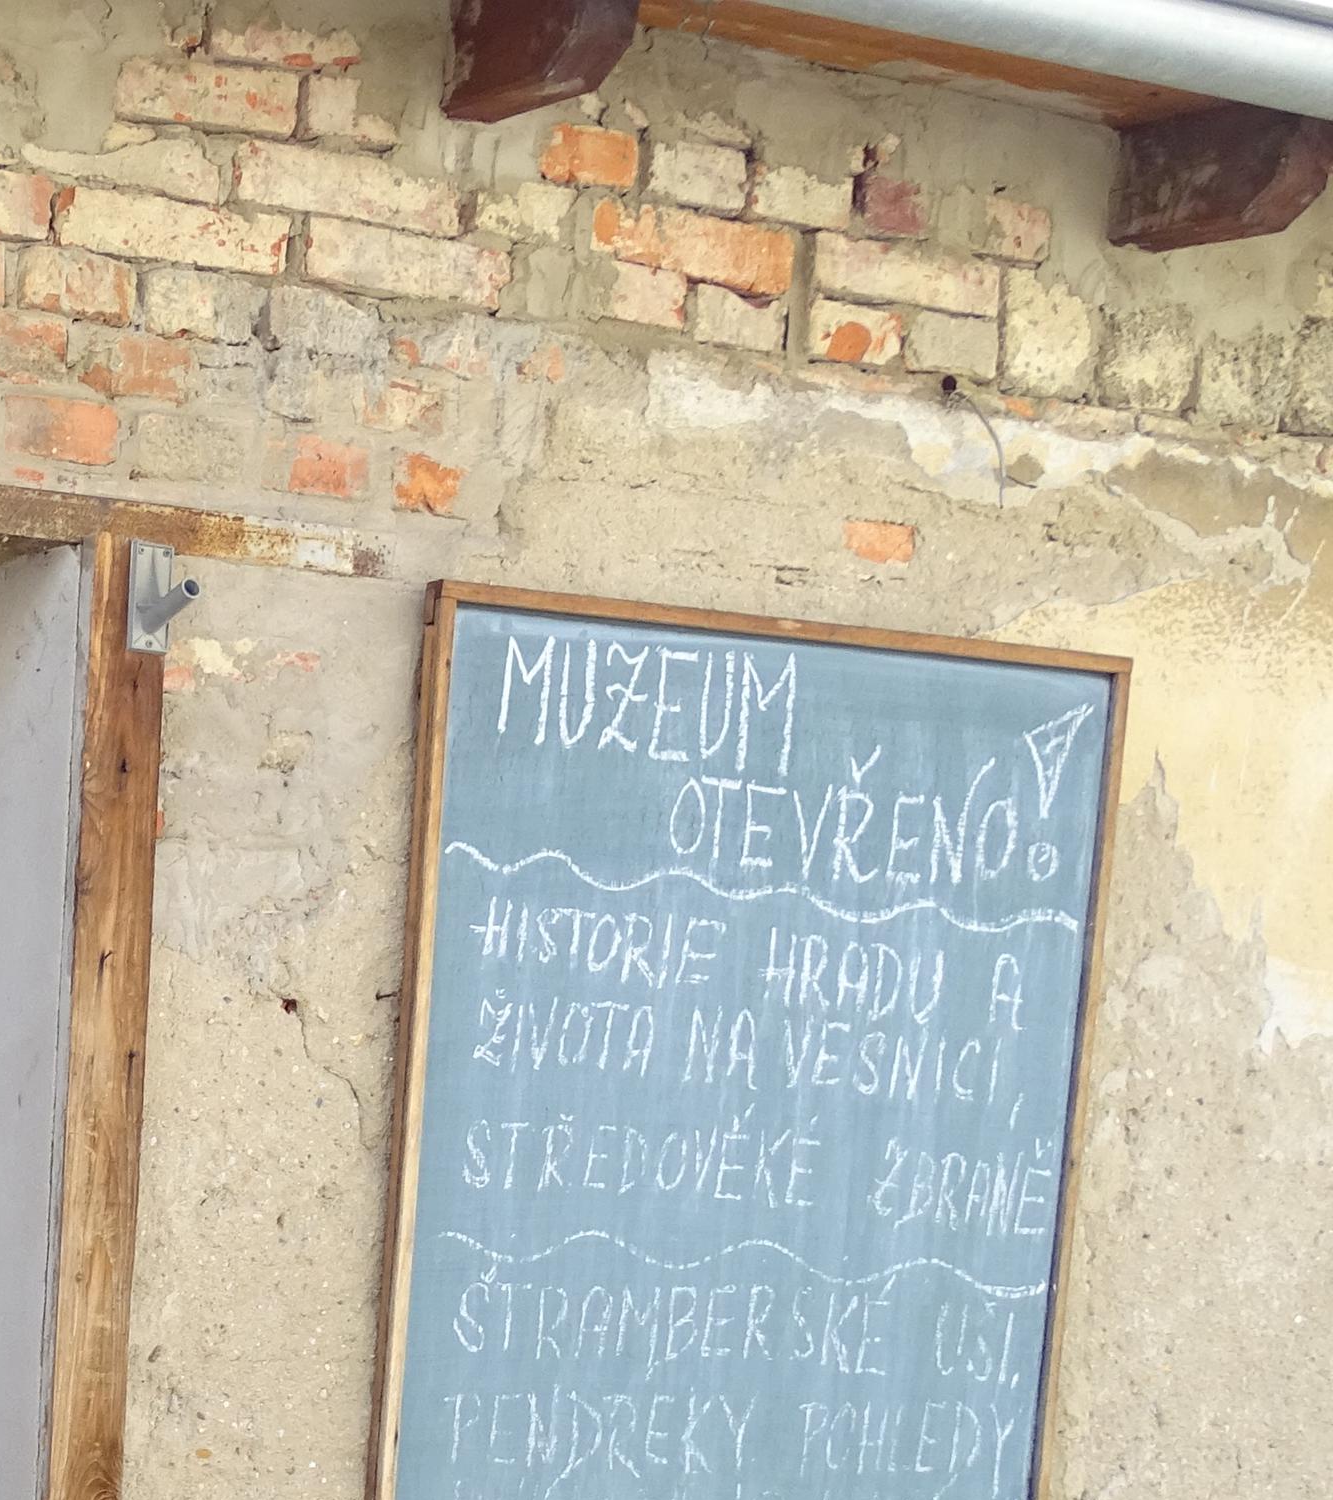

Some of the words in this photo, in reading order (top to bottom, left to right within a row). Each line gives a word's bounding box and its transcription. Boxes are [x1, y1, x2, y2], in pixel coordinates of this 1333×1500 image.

[496, 635, 797, 776] MUZEUM
[471, 897, 728, 990] HISTORIE
[760, 927, 945, 1025] HRADU
[989, 951, 1025, 1031] A
[472, 988, 656, 1077] ŽIVOTA
[682, 1004, 758, 1090] NA
[444, 1384, 758, 1499] PENDREKY
